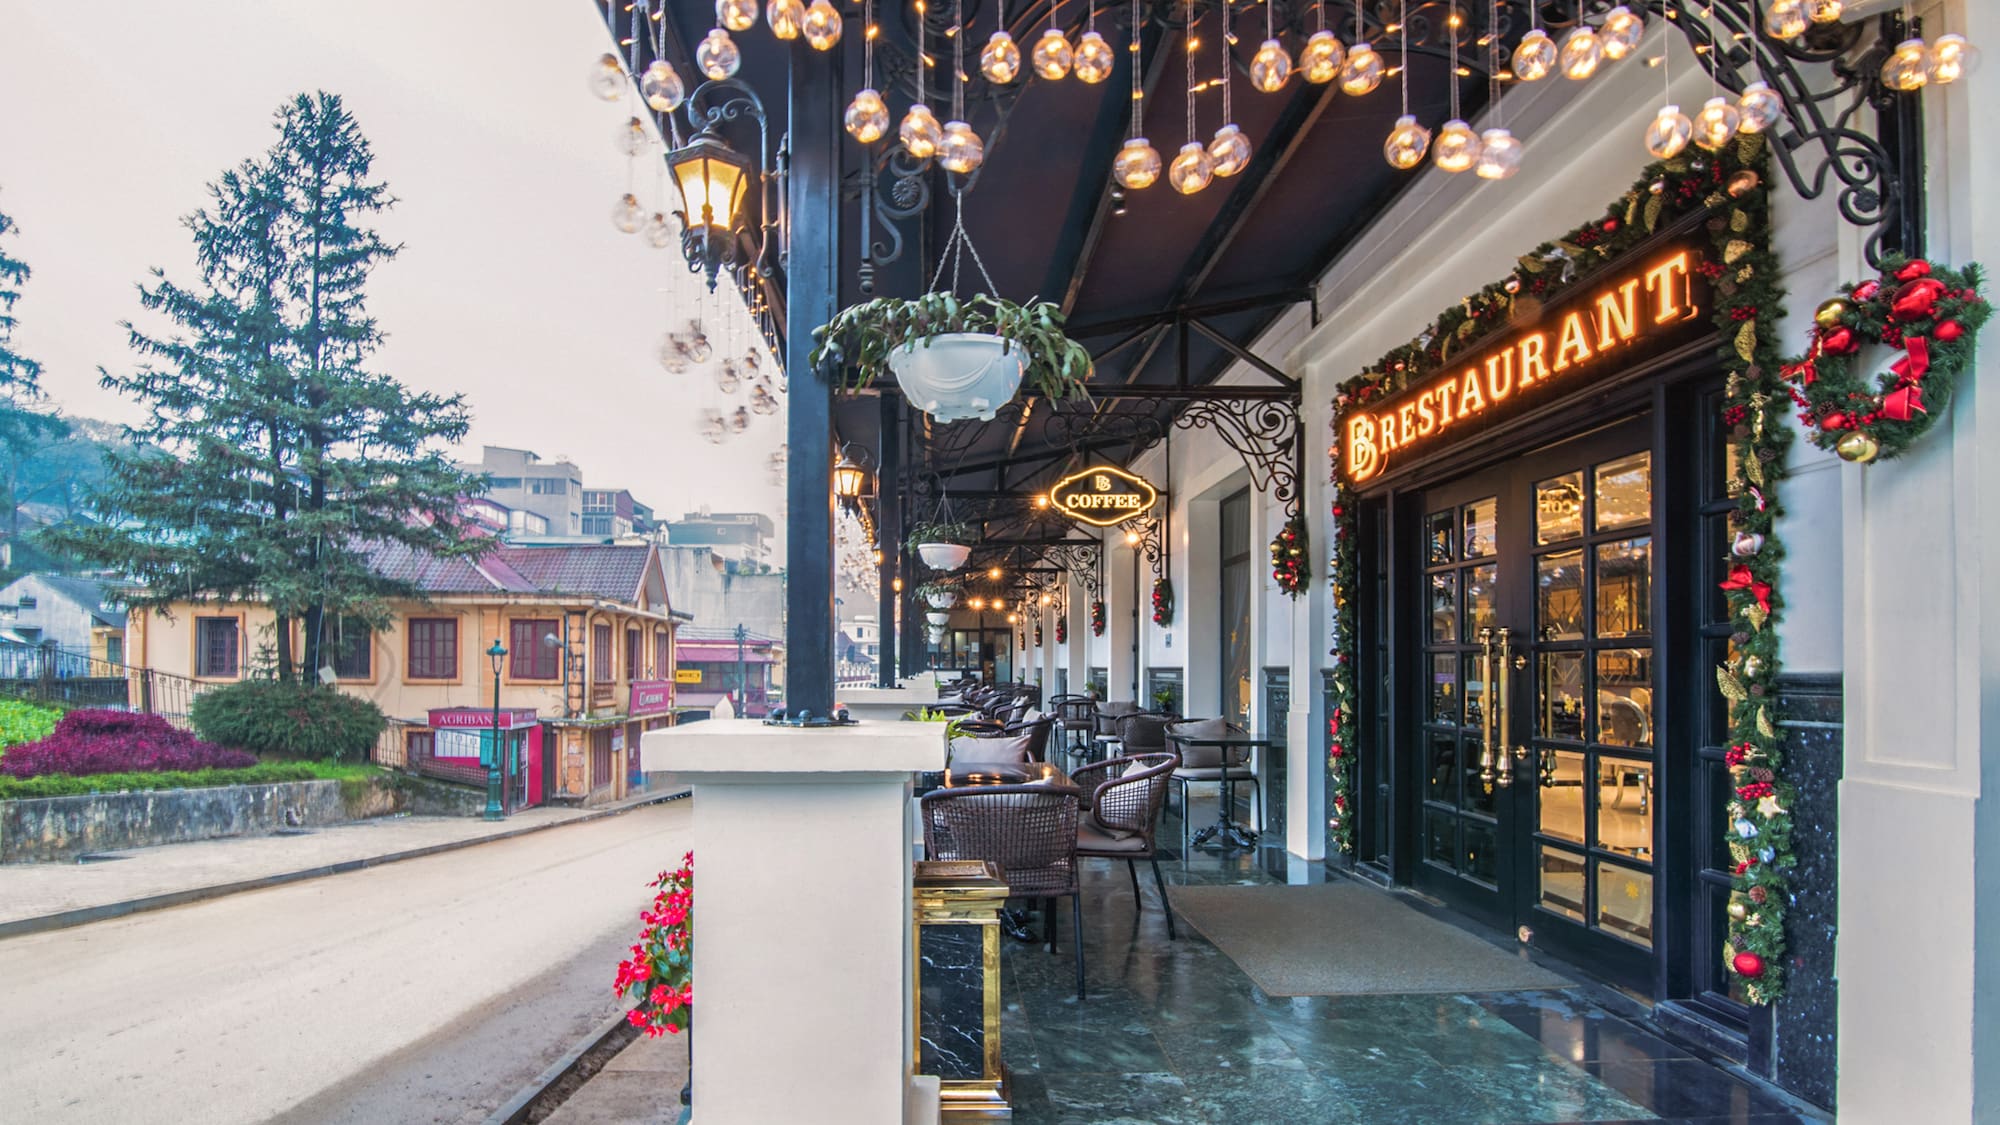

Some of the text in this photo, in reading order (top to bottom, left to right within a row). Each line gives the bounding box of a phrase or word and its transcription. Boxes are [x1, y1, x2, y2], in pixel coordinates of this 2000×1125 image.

[1379, 251, 1688, 455] RESTAURANT
[1066, 493, 1141, 509] COFFEE
[438, 714, 502, 726] AGRIBAN
